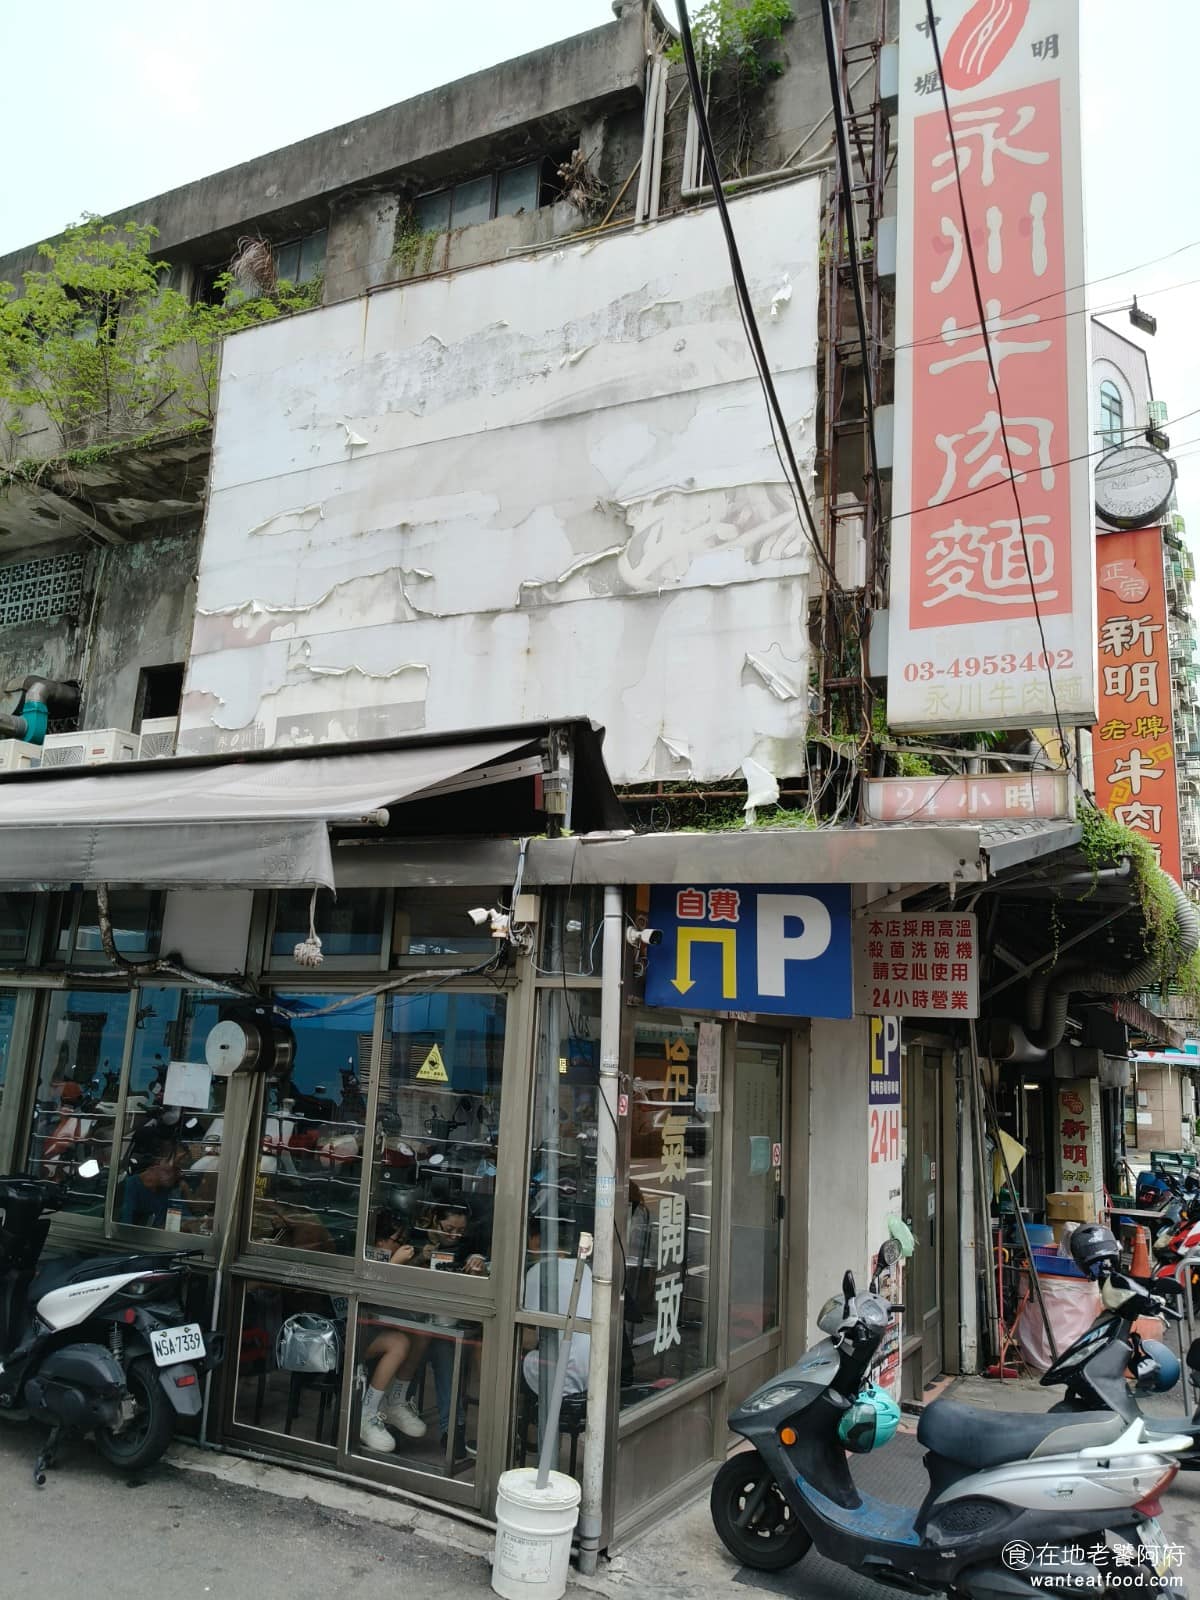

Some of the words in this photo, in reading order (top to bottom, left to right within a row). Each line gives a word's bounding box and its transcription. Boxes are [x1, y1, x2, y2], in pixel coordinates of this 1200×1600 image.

[921, 105, 1058, 609] 永川牛肉麵
[903, 649, 1074, 682] 03-4953402
[1099, 615, 1164, 706] 新明
[1101, 716, 1168, 741] 老牌
[895, 782, 1041, 816] 24小時
[1106, 748, 1166, 868] 牛肉
[676, 888, 741, 921] 自費
[868, 919, 973, 938] 本店採用高溫
[757, 893, 832, 998] P
[868, 941, 973, 960] 殺菌洗碗機
[872, 962, 969, 981] 請安心使用
[872, 988, 969, 1010] 24小時營業
[883, 1015, 899, 1076] P
[871, 1109, 899, 1164] 24H
[1061, 1118, 1090, 1168] 新明
[154, 1332, 201, 1358] NSA-7339
